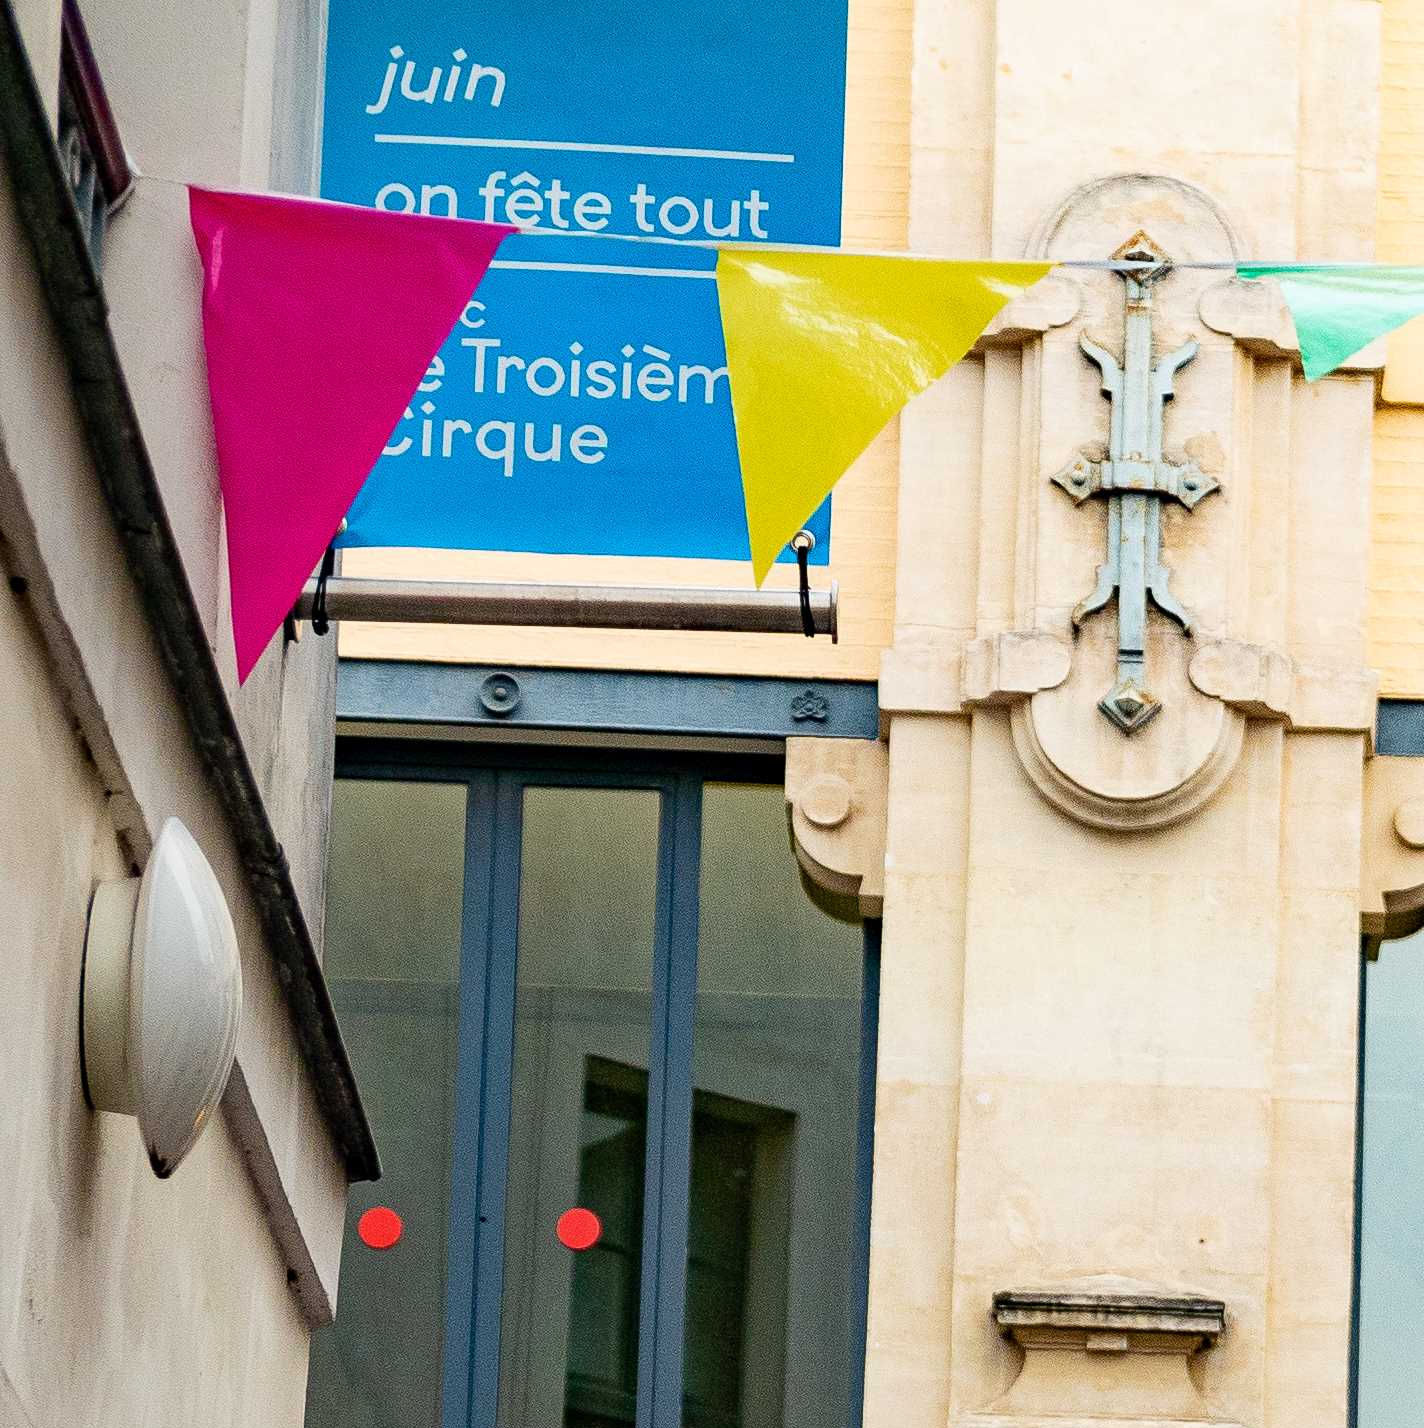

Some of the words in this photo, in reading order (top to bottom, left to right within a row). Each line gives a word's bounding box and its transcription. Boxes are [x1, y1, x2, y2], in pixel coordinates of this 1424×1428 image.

[365, 44, 506, 114] juin
[374, 182, 458, 220] on
[478, 170, 612, 231] fête
[629, 183, 770, 239] tout
[416, 355, 446, 392] e
[461, 337, 729, 404] Troisièm
